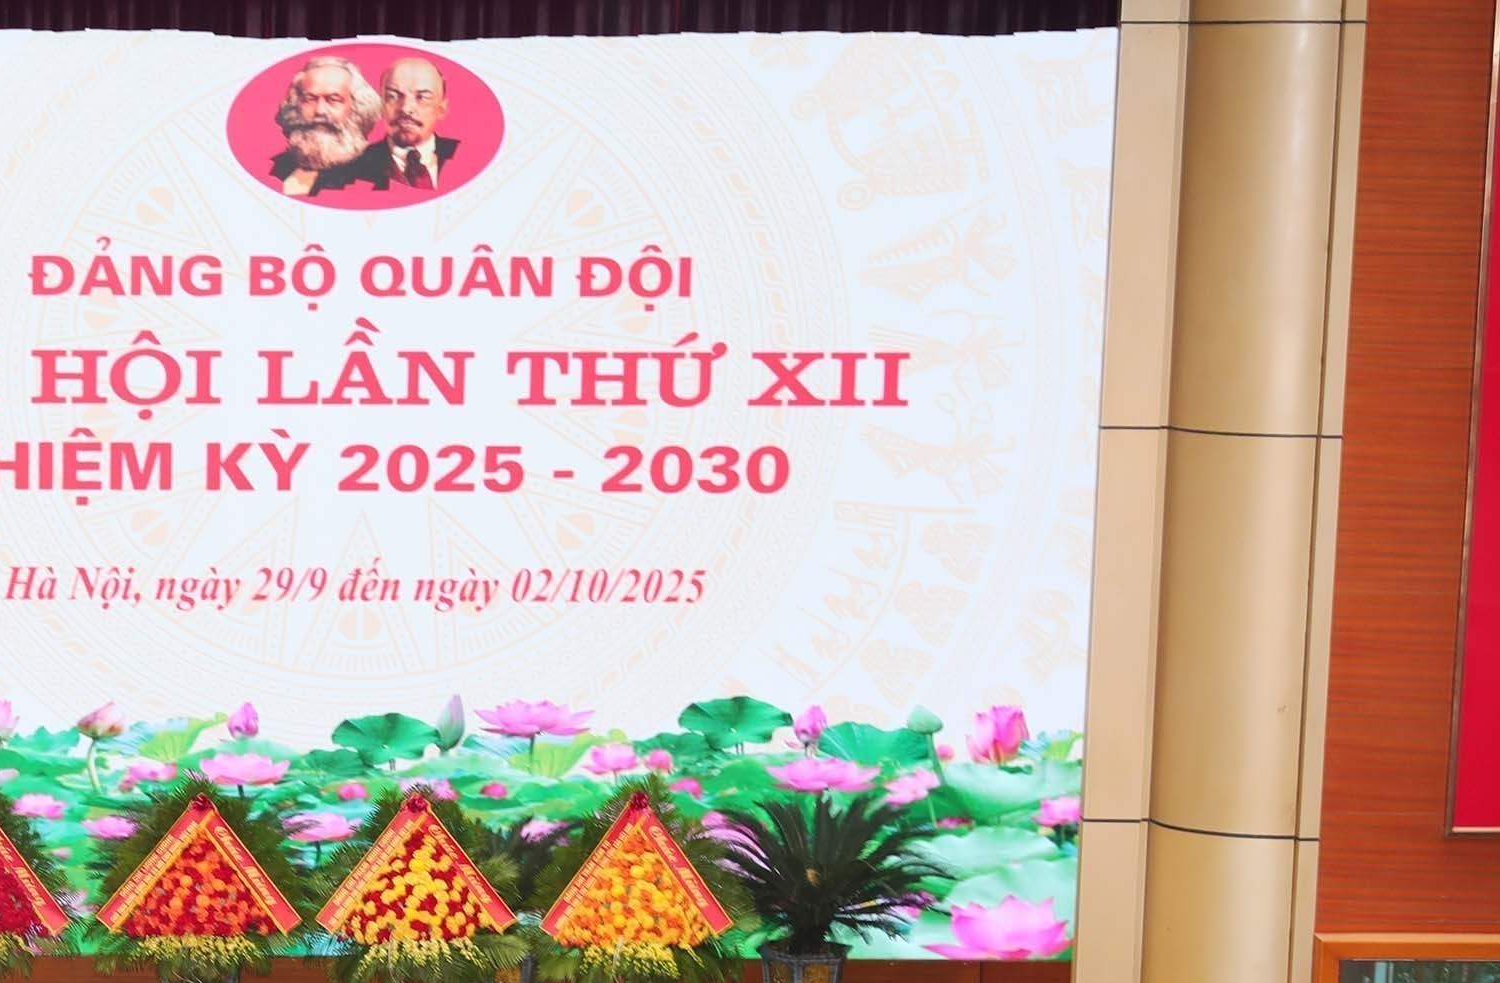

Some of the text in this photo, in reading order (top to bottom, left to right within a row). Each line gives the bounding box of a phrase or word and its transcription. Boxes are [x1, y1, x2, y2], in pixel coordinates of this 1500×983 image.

[30, 237, 693, 311] ĐẢNG BỘ QUÂN ĐỘI
[32, 330, 220, 420] HỘI
[257, 317, 474, 406] LẦN
[507, 332, 727, 407] THỨ
[748, 352, 910, 407] XII
[206, 429, 309, 491] KỲ
[338, 445, 524, 493] 2025
[554, 470, 573, 478] -
[602, 445, 790, 494] 2030
[5, 556, 707, 612] Hà Nội, ngày 29/9 đến ngày 02/10/2025
[12, 866, 45, 905] Mừng
[214, 826, 277, 906] Chúc Mừng
[429, 825, 492, 904] Chúc Mừng
[648, 826, 709, 906] Chúc Mừng
